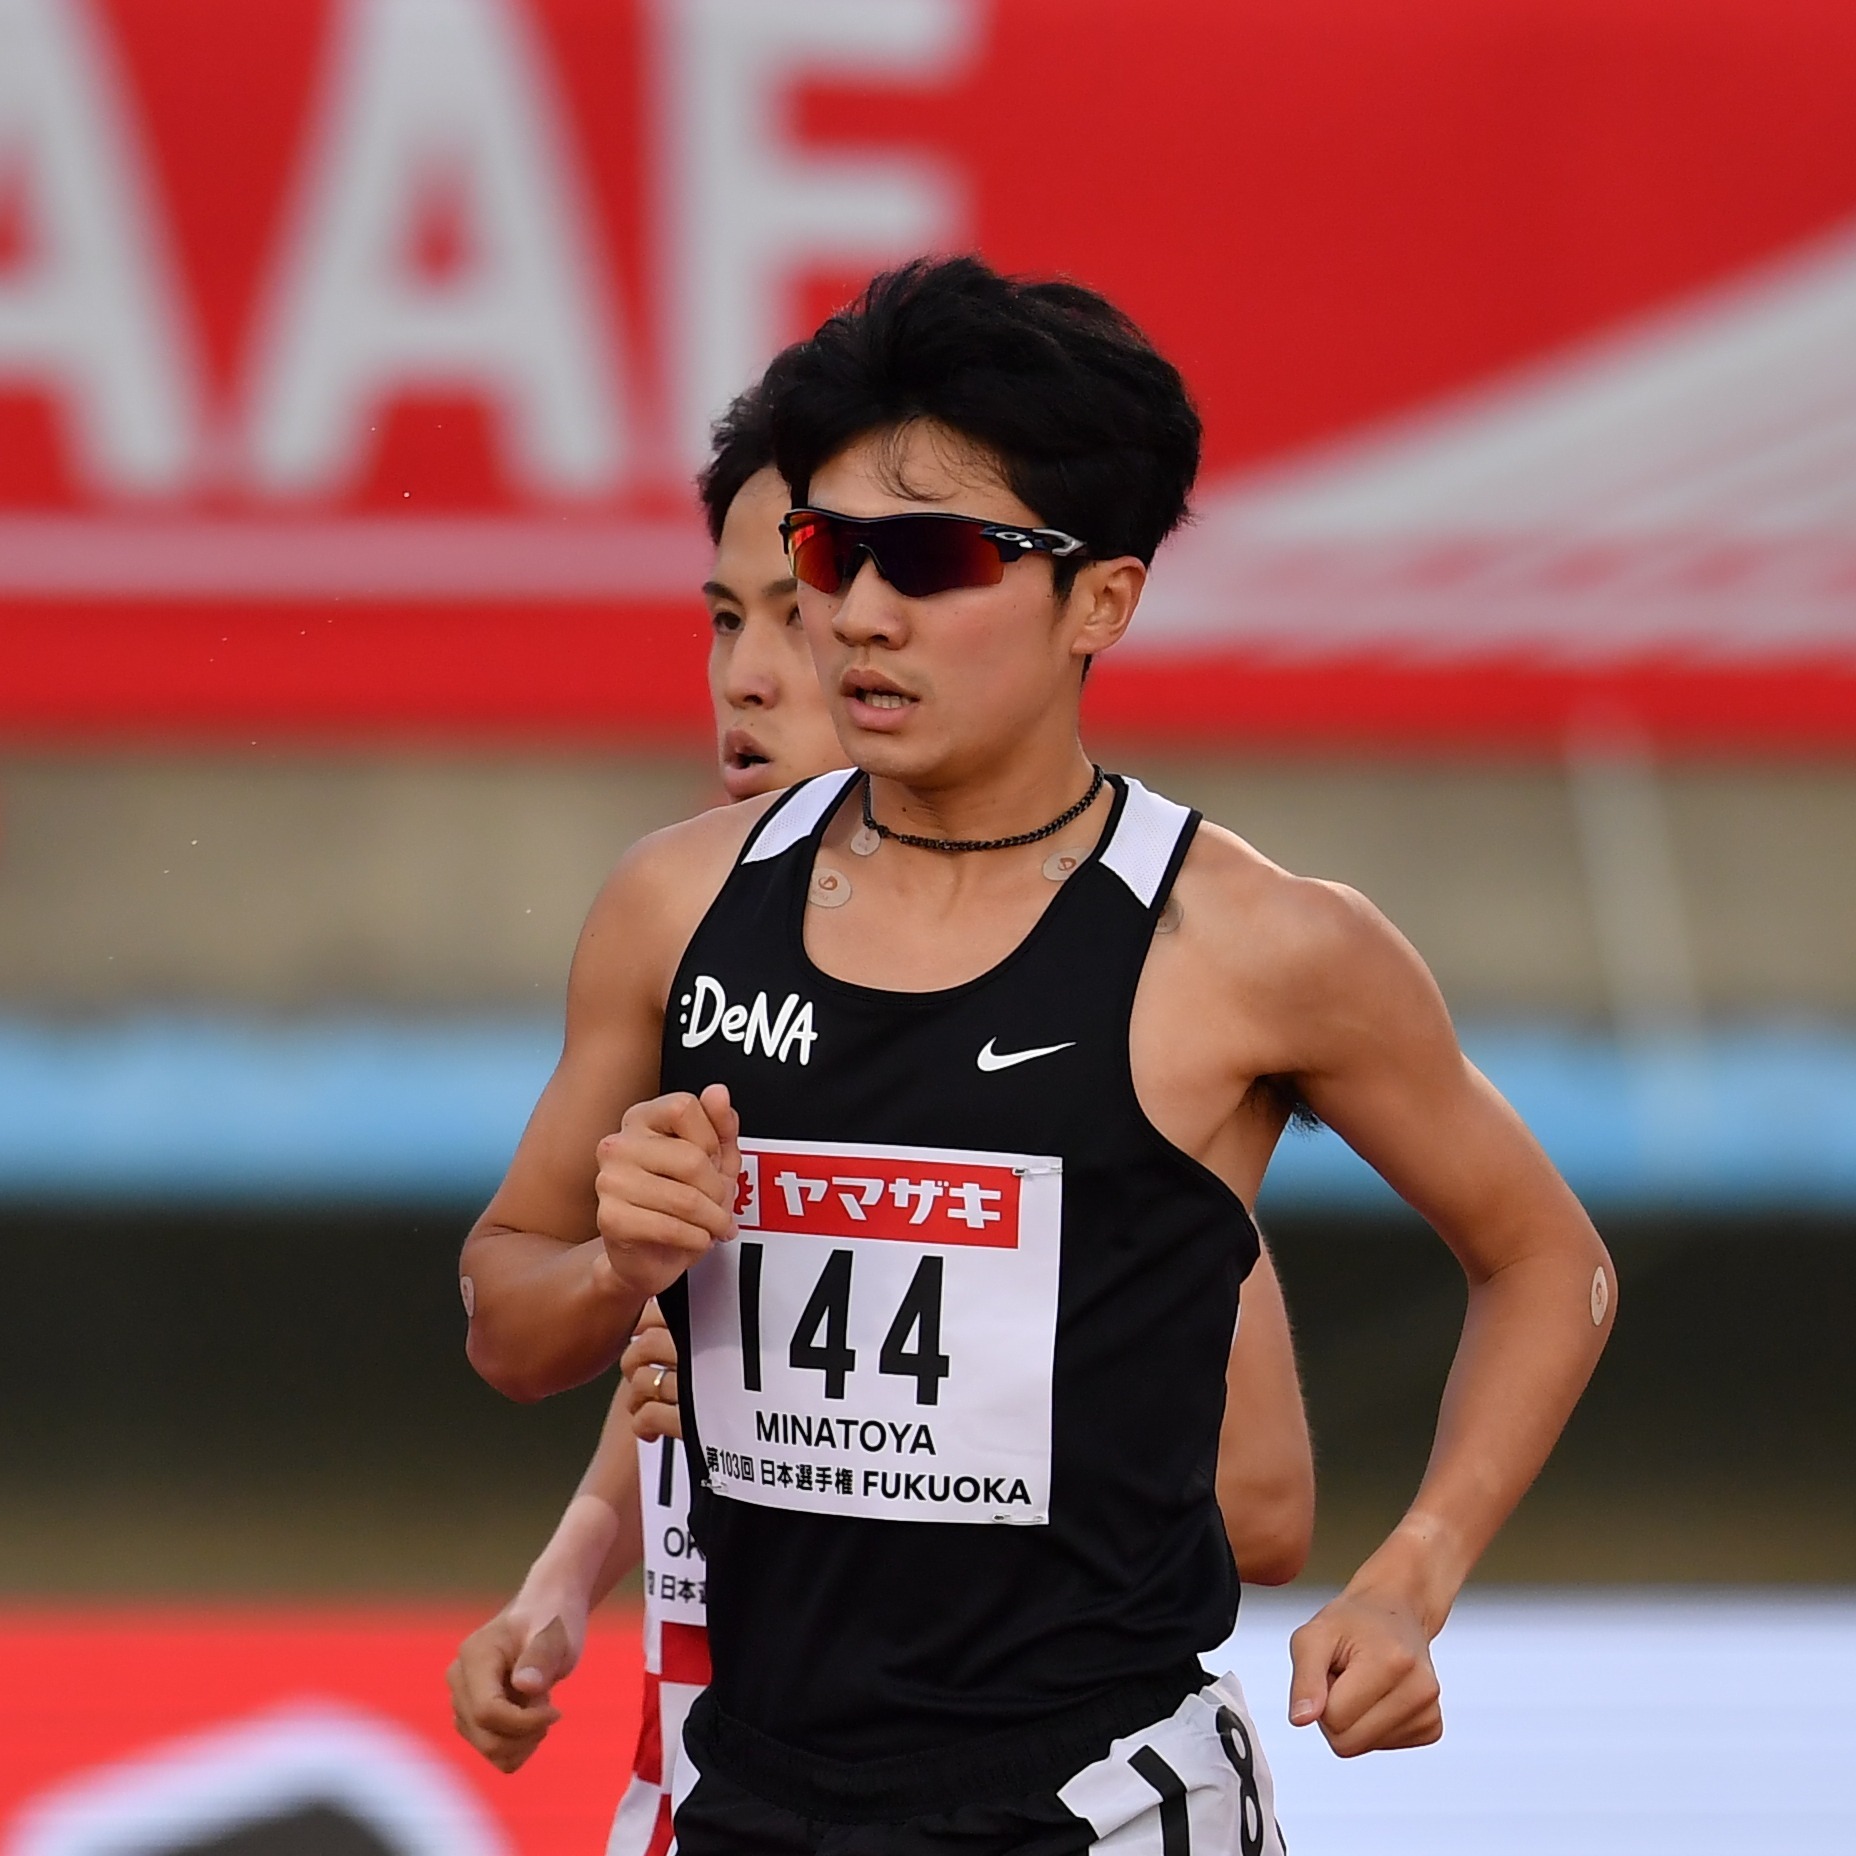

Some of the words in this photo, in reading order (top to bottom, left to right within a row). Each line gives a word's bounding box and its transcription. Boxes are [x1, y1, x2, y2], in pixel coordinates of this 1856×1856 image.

[773, 1168, 1003, 1230] ヤマザキ
[738, 1241, 951, 1407] 144
[755, 1410, 937, 1456] MINATOYA
[706, 1445, 755, 1482] 第103回
[760, 1458, 854, 1496] 日本選手権
[862, 1470, 1031, 1506] FUKUOKA
